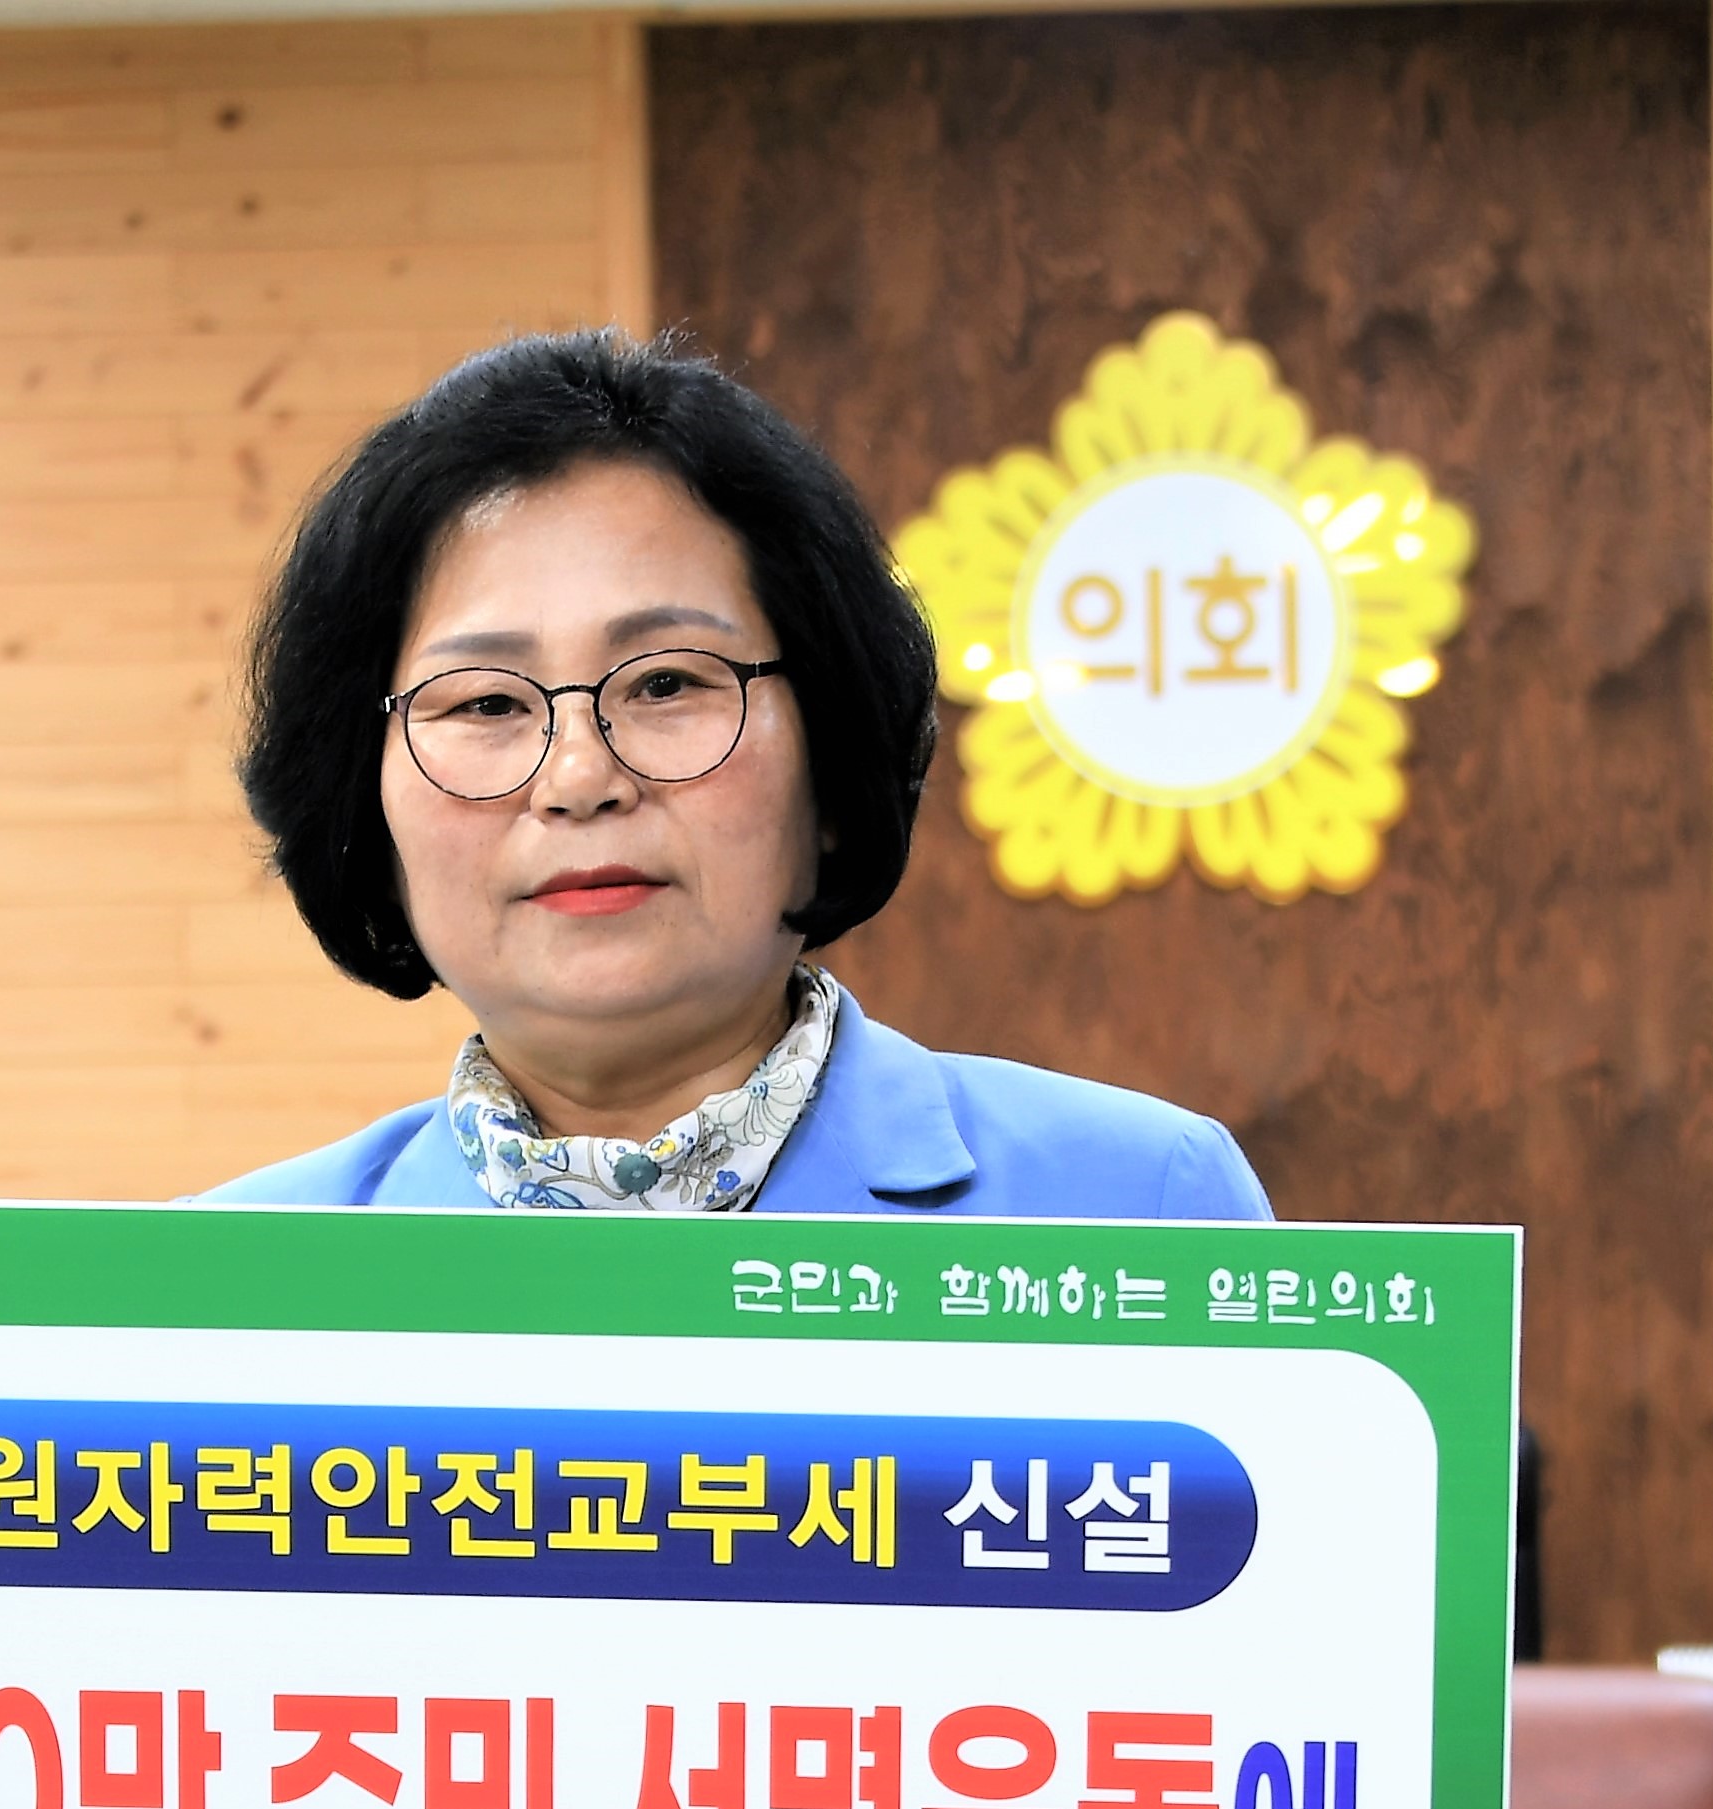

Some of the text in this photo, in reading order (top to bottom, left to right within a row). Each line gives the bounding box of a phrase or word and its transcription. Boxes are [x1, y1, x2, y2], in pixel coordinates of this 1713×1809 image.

[1059, 556, 1298, 697] 의회
[732, 1260, 1436, 1325] 군민과 함께하는 열린의회
[943, 1459, 1172, 1573] 신설
